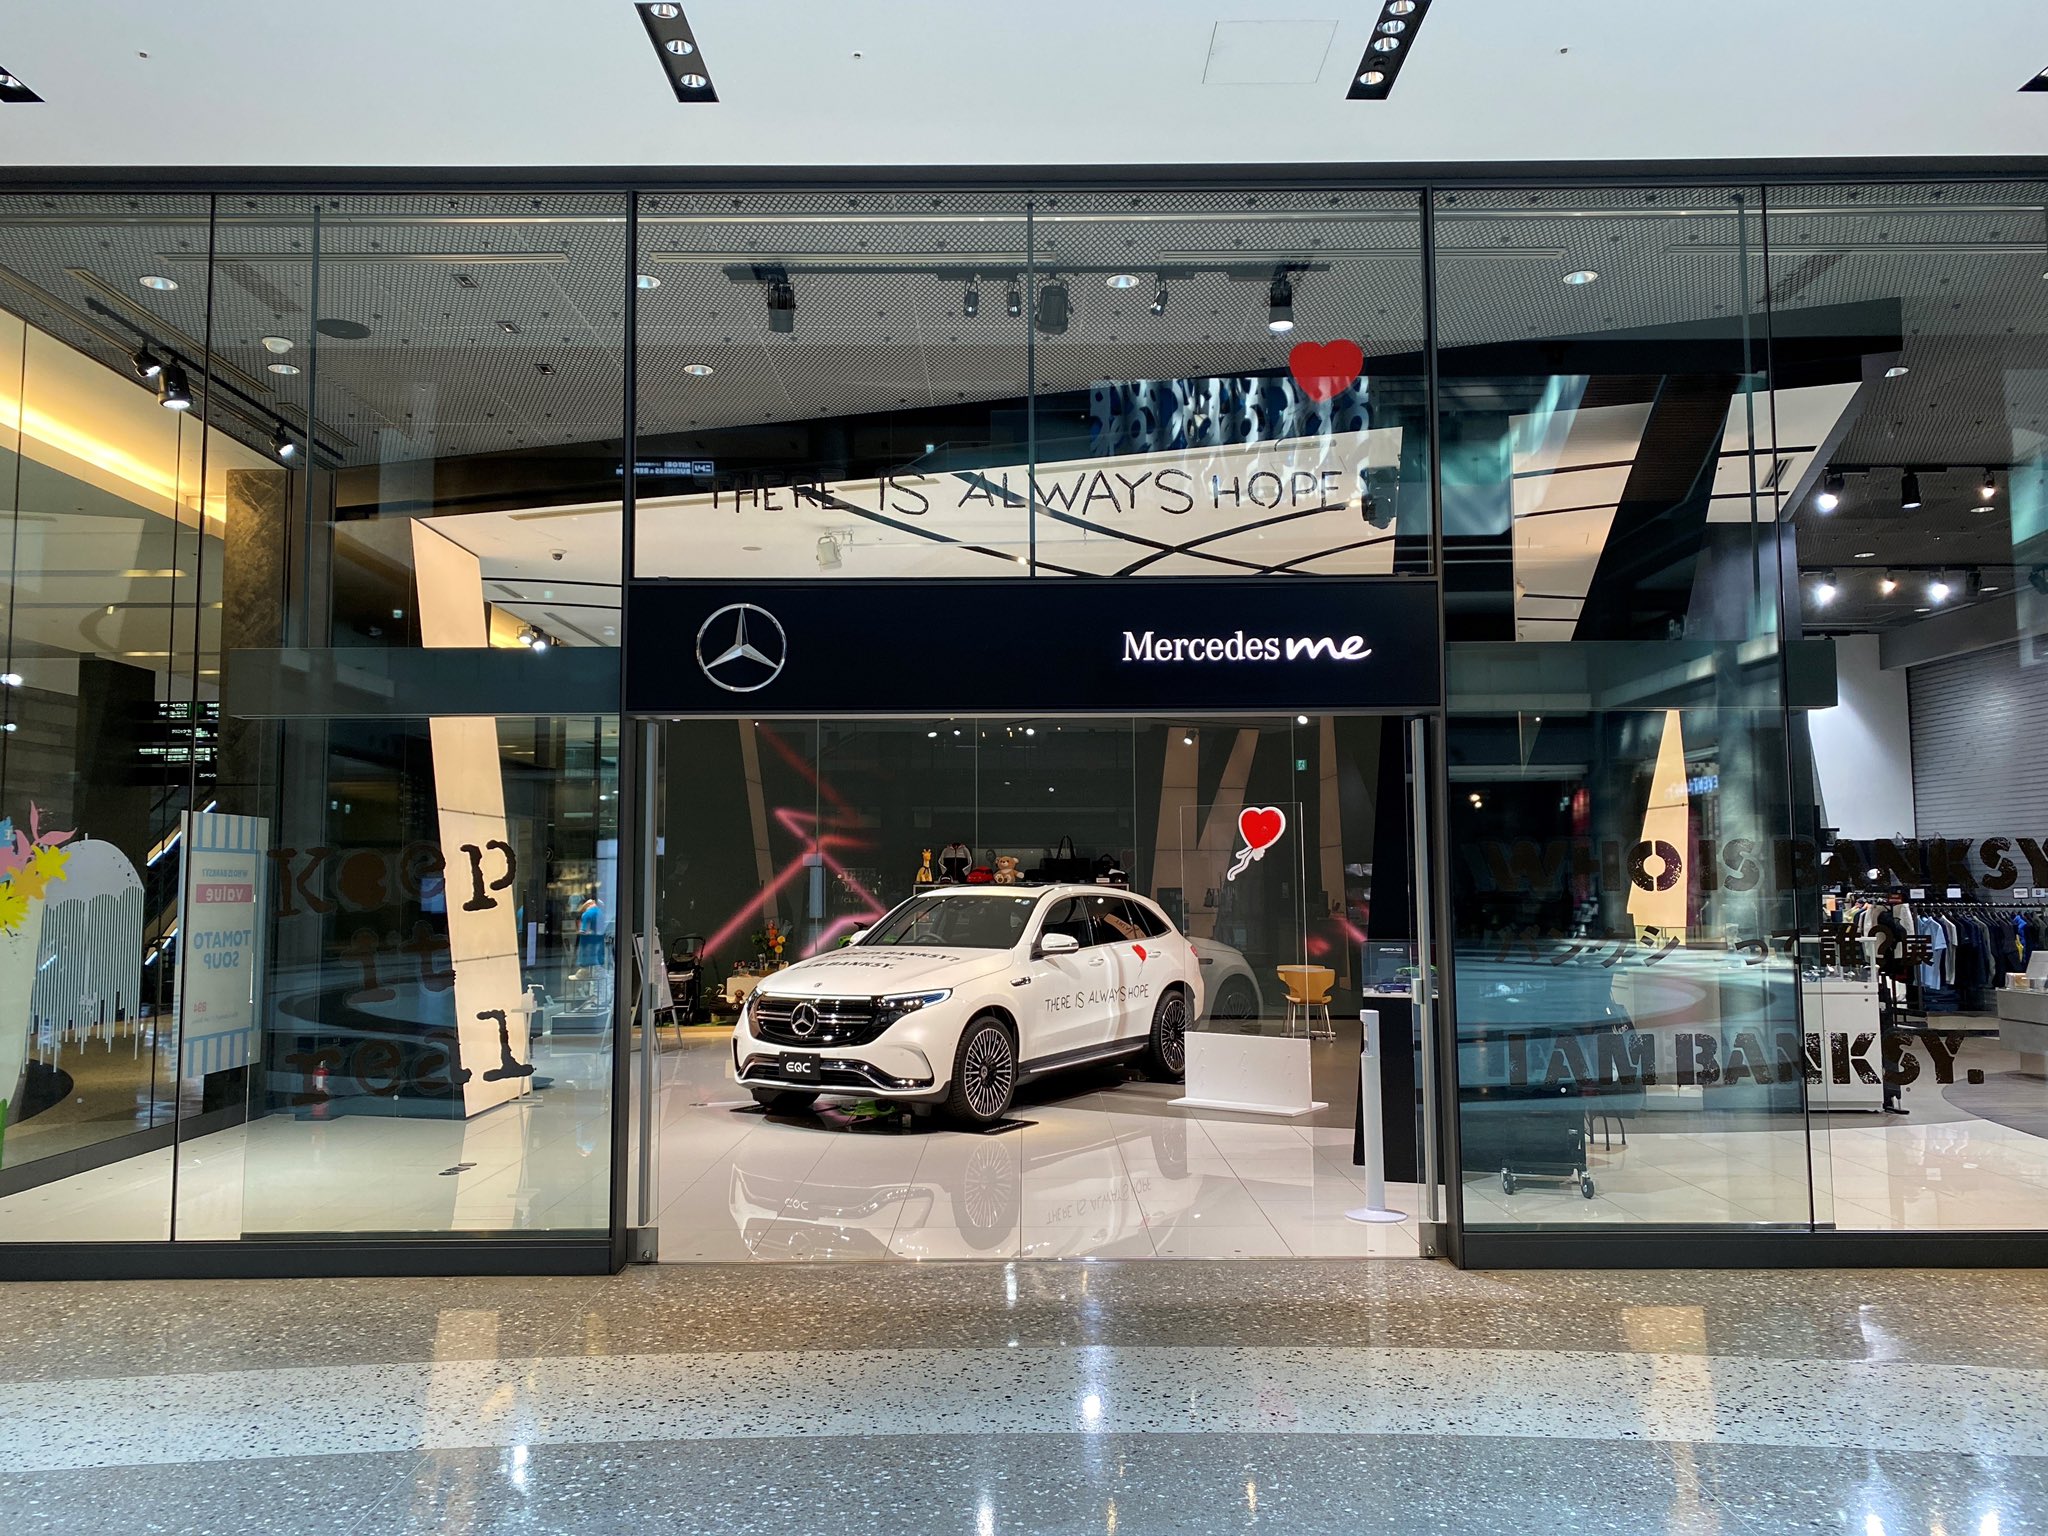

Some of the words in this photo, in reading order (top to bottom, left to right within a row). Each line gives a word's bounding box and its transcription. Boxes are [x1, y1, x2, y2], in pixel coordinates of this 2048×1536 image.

[879, 467, 930, 515] IS
[958, 468, 1193, 515] ALWAYS
[1213, 471, 1346, 509] HOPE
[1122, 630, 1281, 661] Mercedes
[1286, 635, 1372, 661] me
[1480, 840, 1682, 892] WHO
[1698, 839, 1760, 892] IS
[342, 924, 457, 1004] it
[1044, 994, 1072, 1013] THERE
[1075, 991, 1085, 1009] IS
[1088, 985, 1127, 1004] ALWAYS
[1128, 983, 1149, 998] HOPE
[285, 1009, 537, 1105] real
[786, 1062, 811, 1073] EQC
[1508, 1034, 1528, 1086] I
[1545, 1033, 1656, 1086] AM
[1675, 1032, 1985, 1086] BANKSY.
